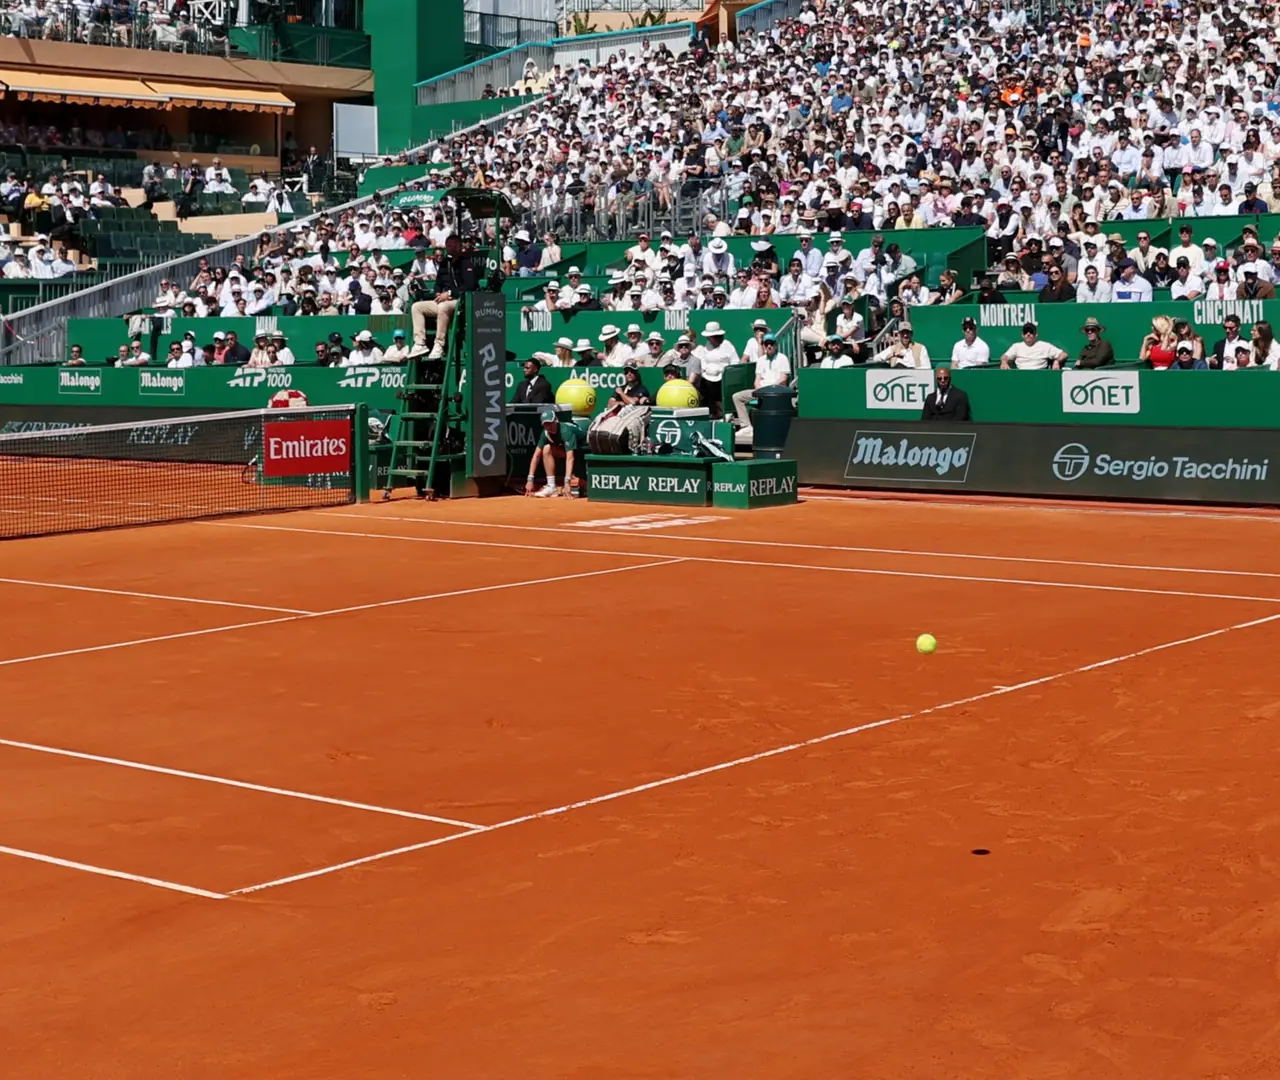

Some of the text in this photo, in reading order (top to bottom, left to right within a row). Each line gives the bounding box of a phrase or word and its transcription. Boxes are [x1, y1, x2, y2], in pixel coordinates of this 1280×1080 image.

[399, 194, 435, 205] RUMMO
[475, 307, 504, 319] RUMMO
[664, 310, 690, 331] ROME
[980, 304, 1039, 326] MONTREAL
[1193, 300, 1264, 325] CINCINNATI
[60, 372, 101, 391] Malongo
[140, 372, 184, 392] Malongo
[226, 367, 266, 388] ATP
[267, 374, 292, 388] 1000
[336, 367, 380, 388] ATP
[570, 368, 626, 389] Adecco
[873, 376, 930, 403] ONET
[1070, 378, 1134, 406] ONET
[478, 342, 501, 467] RUMMO
[269, 436, 347, 460] Emirates
[853, 437, 970, 477] Malongo
[1094, 454, 1269, 481] Sergio Tacchini
[591, 474, 641, 491] REPLAY
[648, 476, 701, 494] REPLAY
[714, 482, 746, 493] REPLAY
[749, 476, 796, 497] REPLAY
